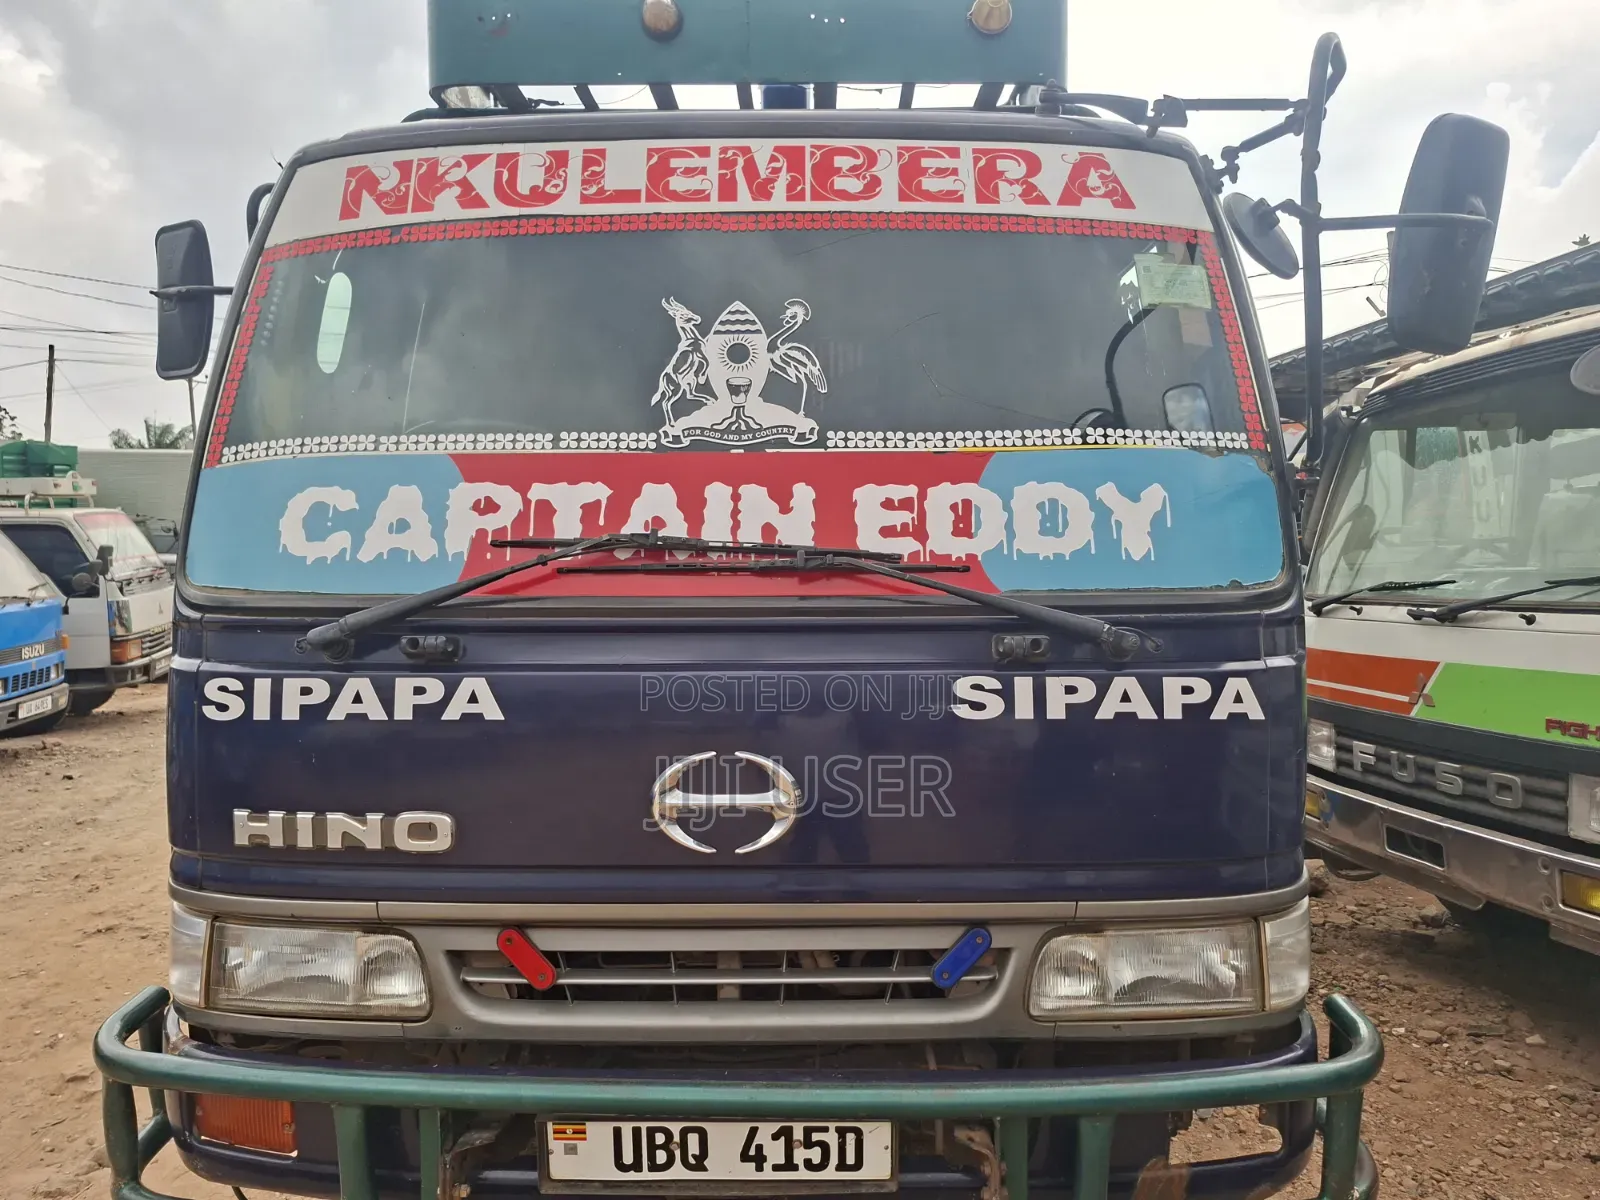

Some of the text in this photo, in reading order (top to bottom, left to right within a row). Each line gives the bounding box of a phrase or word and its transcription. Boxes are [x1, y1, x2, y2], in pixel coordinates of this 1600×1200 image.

[338, 145, 1137, 221] NKULEMBERA
[684, 429, 701, 437] FOR
[704, 430, 721, 439] GOD
[741, 433, 753, 441] MY
[755, 427, 795, 438] COUNTRY
[279, 481, 1171, 565] CAPTAIN EDDY
[21, 643, 45, 660] ISUZU
[201, 676, 505, 722] SIPAPA
[951, 675, 1266, 720] SIPAPA
[1352, 741, 1522, 809] FUSO
[233, 808, 457, 853] HINO
[612, 1125, 865, 1173] UBQ 415D
